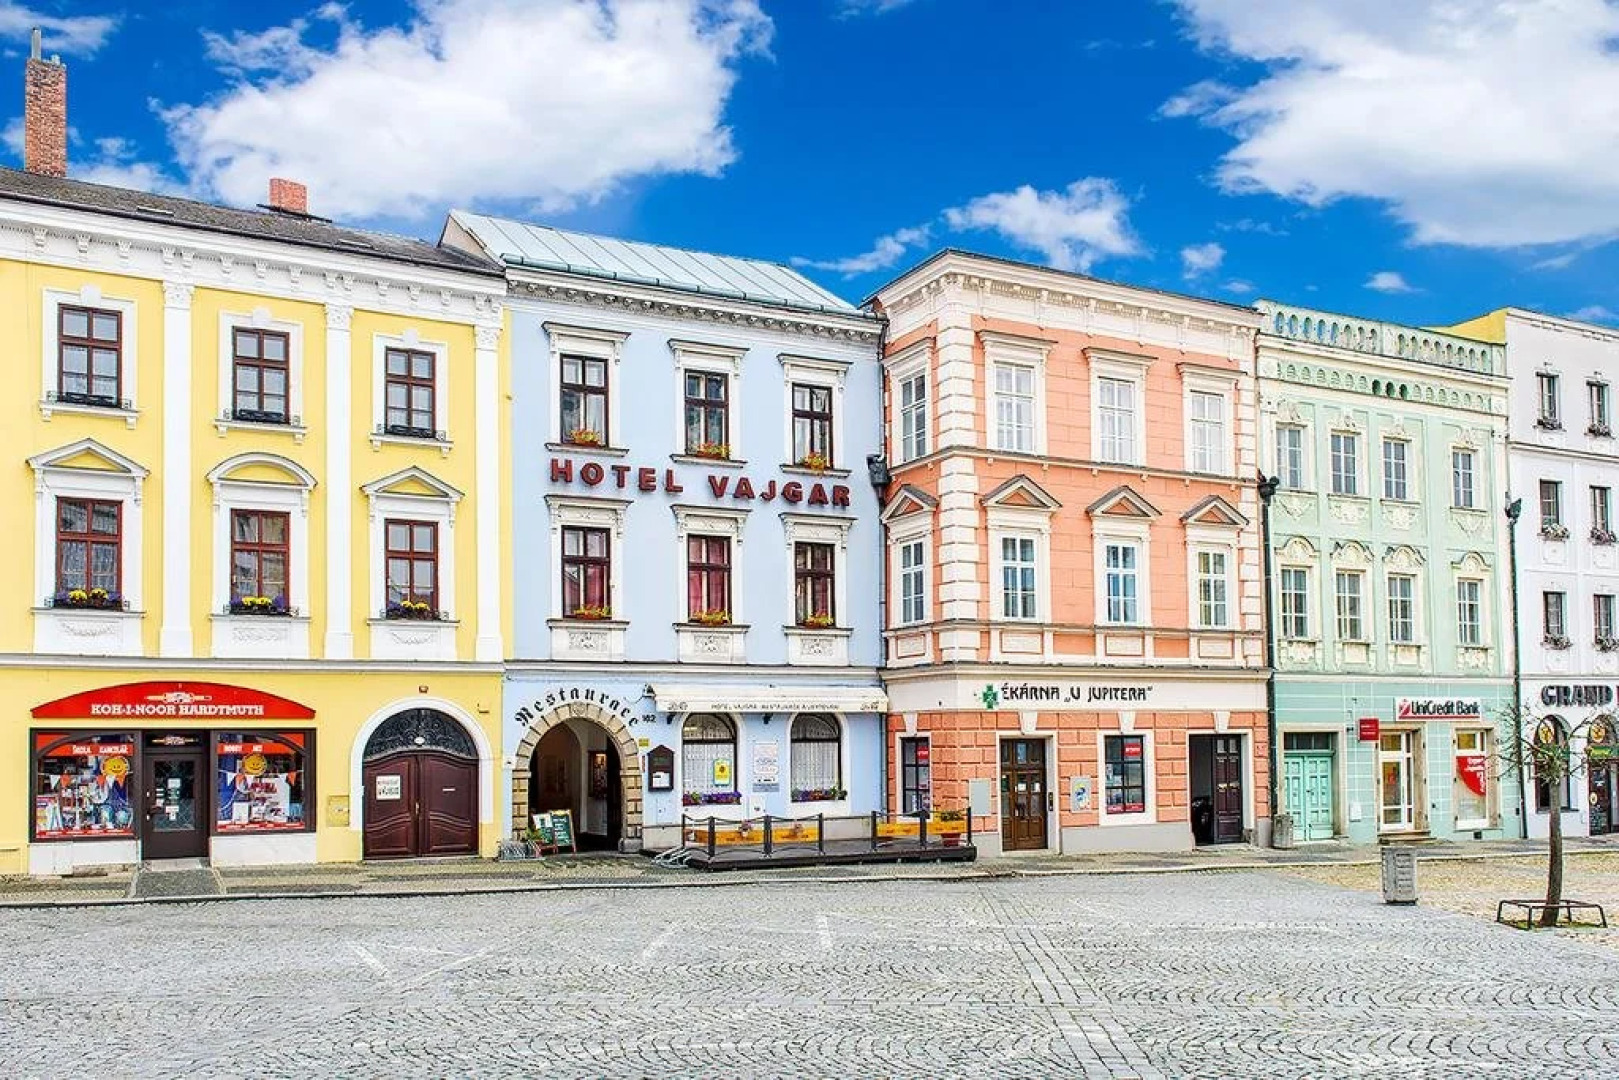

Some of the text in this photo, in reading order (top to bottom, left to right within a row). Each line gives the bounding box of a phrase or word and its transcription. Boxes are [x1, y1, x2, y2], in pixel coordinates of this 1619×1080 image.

[550, 458, 850, 507] HOTEL VAJGAR
[998, 682, 1060, 700] ÉKÁRNA
[1541, 685, 1613, 707] GRAND
[178, 704, 265, 716] HARDTMUTH
[514, 687, 640, 727] Restaurace
[1411, 700, 1480, 715] UniCredit Bank
